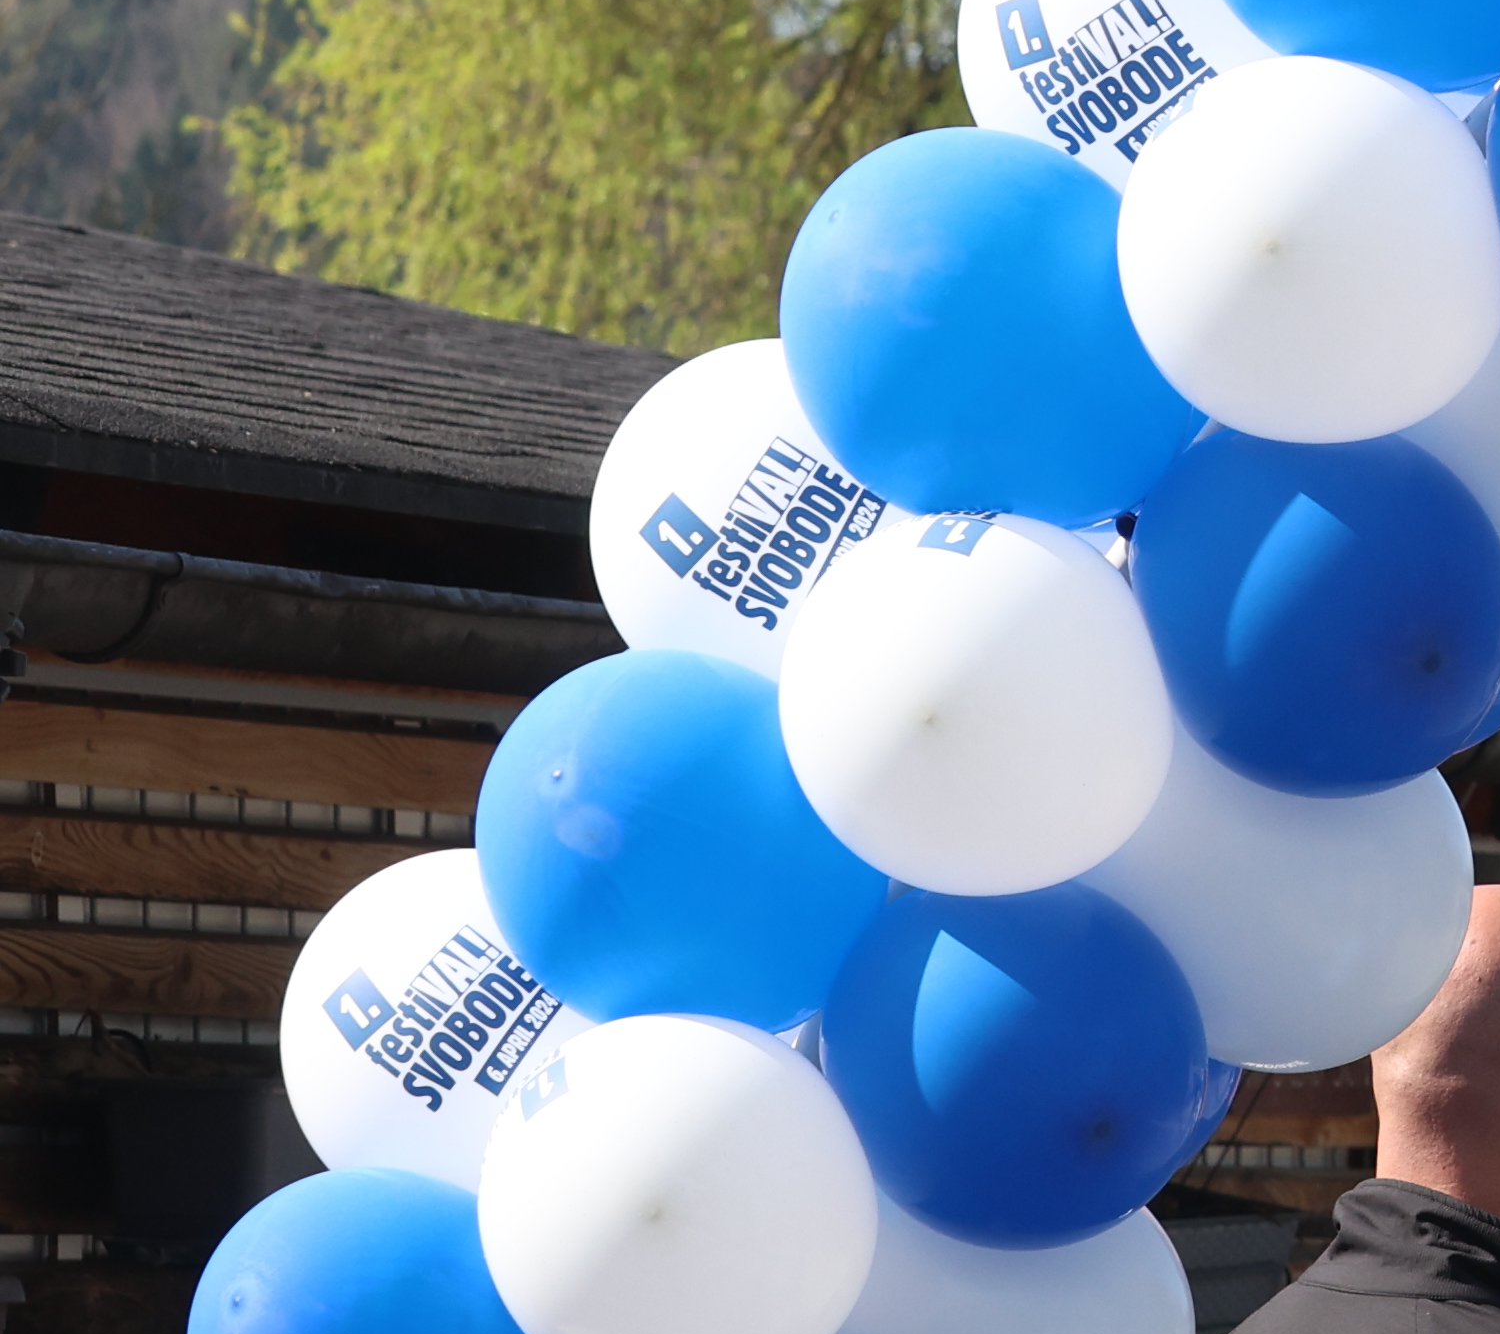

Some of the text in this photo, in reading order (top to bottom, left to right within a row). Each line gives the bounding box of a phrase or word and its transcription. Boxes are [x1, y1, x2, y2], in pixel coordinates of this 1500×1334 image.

[1046, 28, 1207, 156] SVOBODE
[735, 463, 860, 632] SVOBODE
[848, 497, 881, 538] 2024
[402, 955, 540, 1113] SVOBODE
[486, 992, 559, 1083] 6. APRIL 2024
